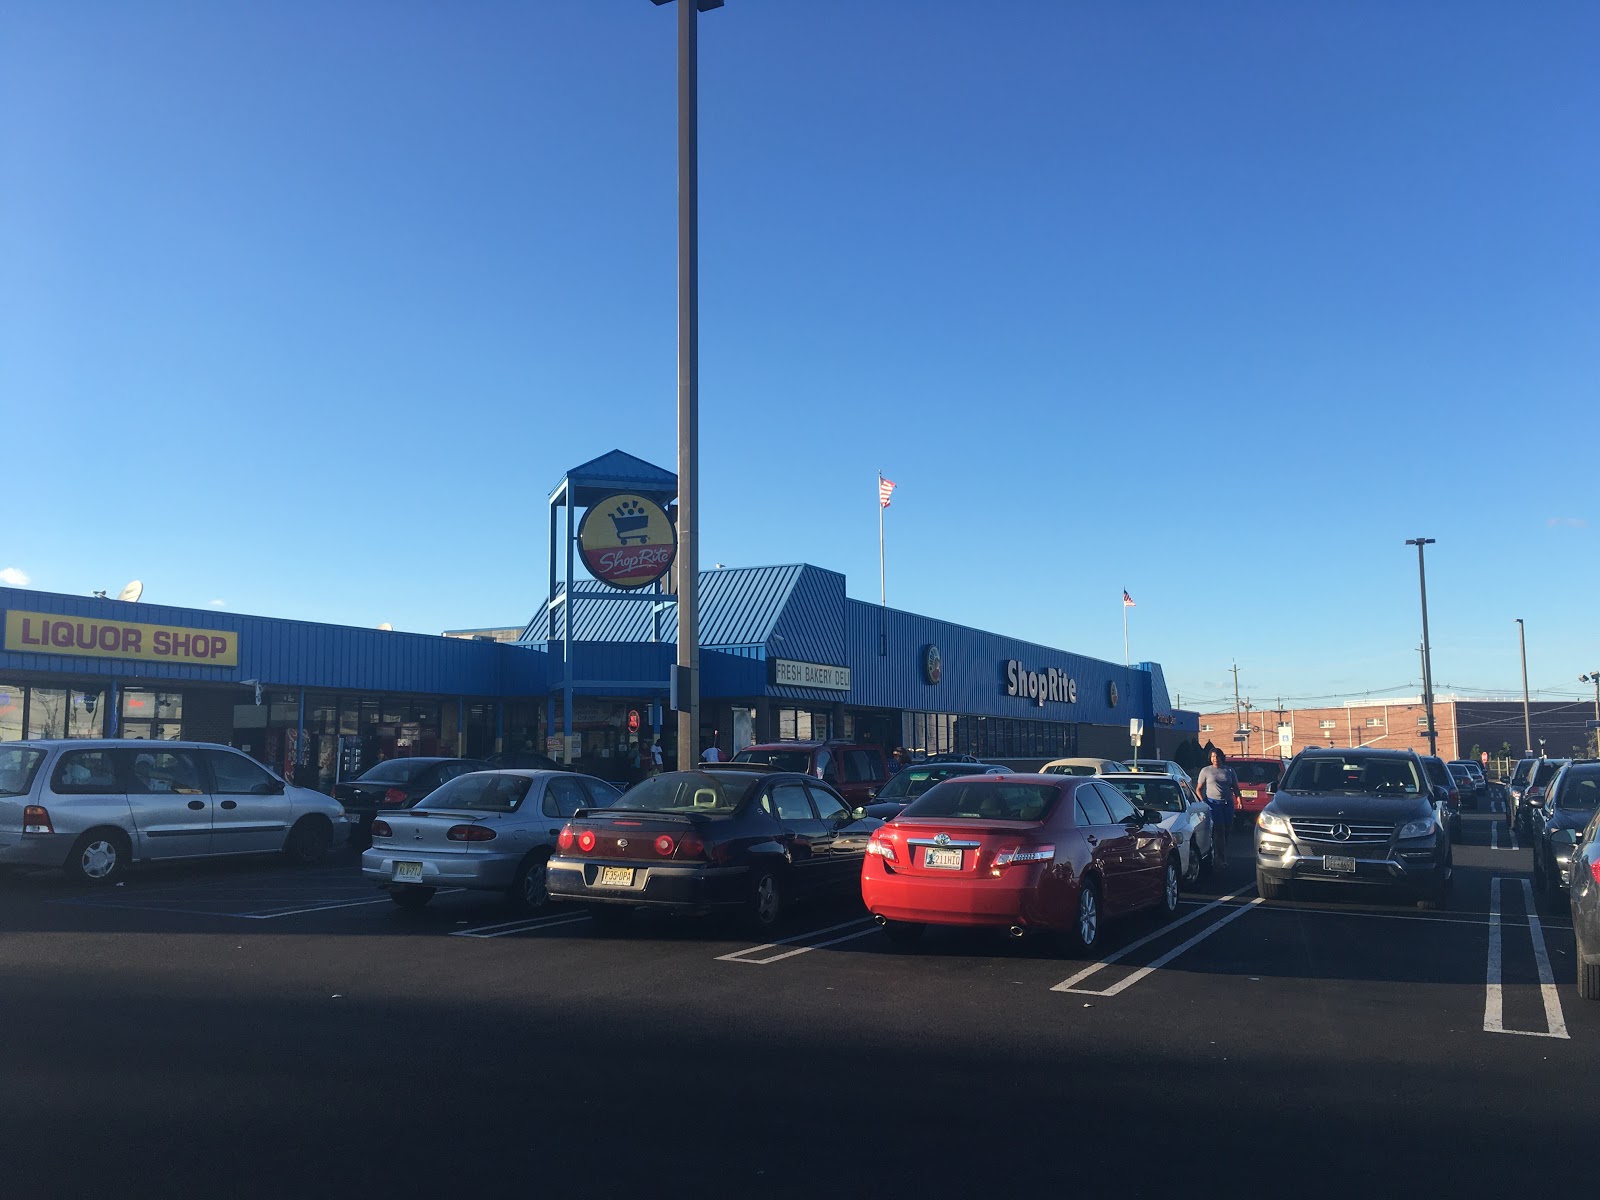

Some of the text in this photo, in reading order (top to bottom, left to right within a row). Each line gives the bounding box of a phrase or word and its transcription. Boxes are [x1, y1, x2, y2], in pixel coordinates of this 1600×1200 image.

[599, 547, 669, 574] ShopRite
[21, 618, 227, 659] LIQUOR SHOP
[777, 663, 850, 686] FRESH BAKERY DELI
[1007, 659, 1077, 707] ShopRite
